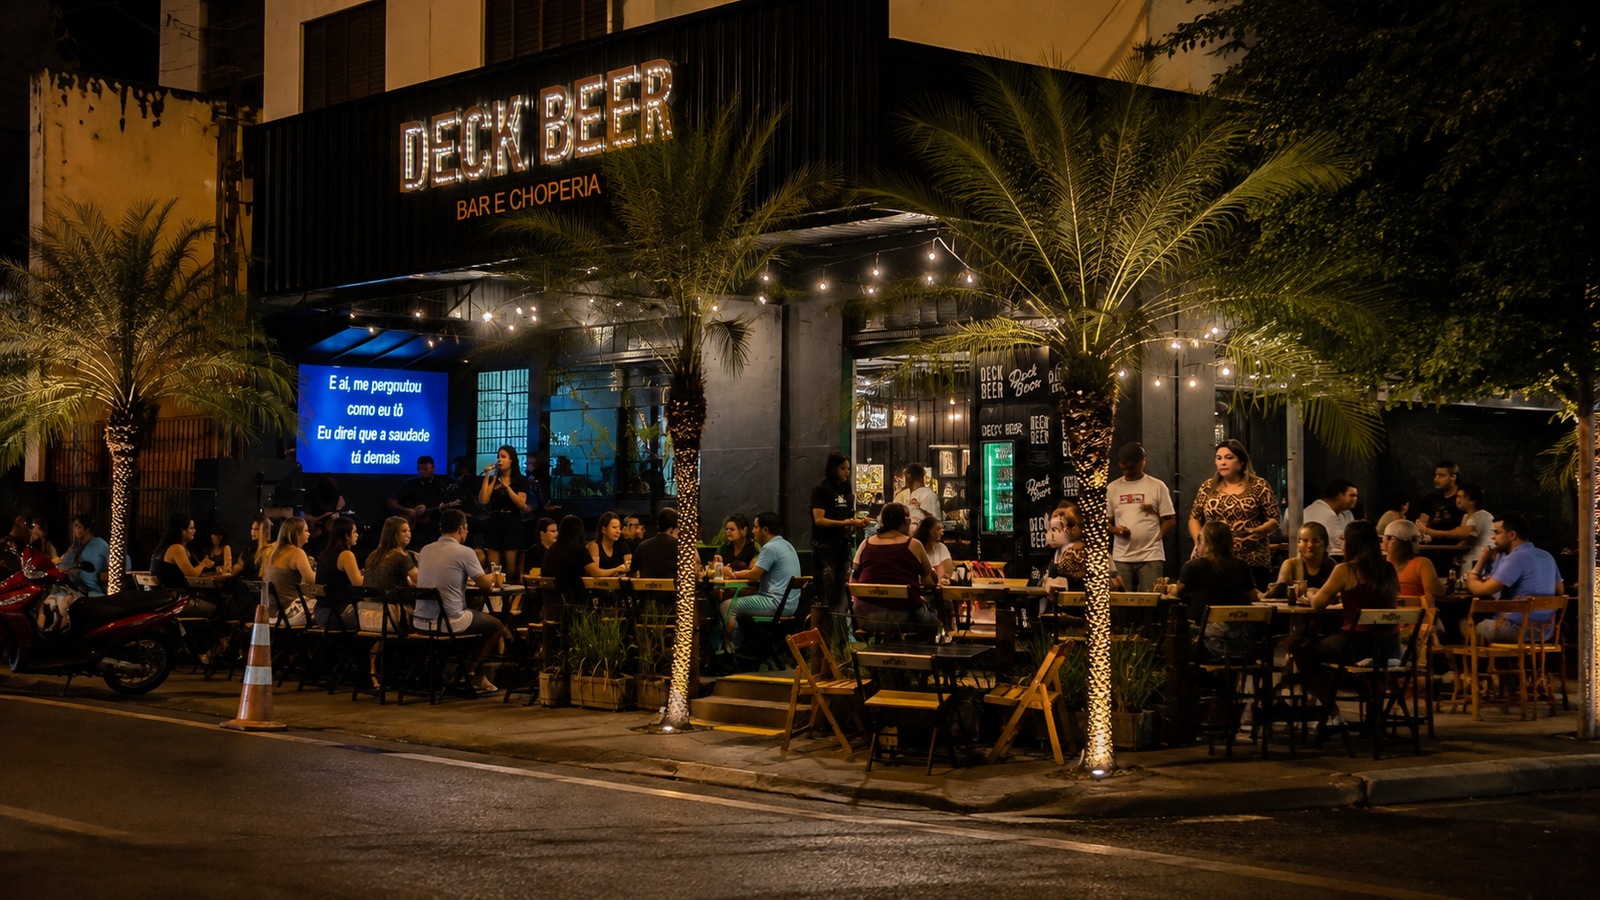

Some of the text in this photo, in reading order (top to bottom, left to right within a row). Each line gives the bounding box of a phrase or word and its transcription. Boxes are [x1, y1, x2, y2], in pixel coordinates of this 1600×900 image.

[399, 58, 674, 193] DECK BEER
[456, 173, 602, 221] BAR E CHOPERIA
[980, 364, 1004, 382] DECK
[329, 374, 337, 390] E
[353, 379, 370, 391] me
[981, 381, 1004, 400] BEER
[347, 404, 375, 416] como
[377, 405, 391, 417] eu
[317, 425, 430, 444] Eu direi que a saudade
[350, 449, 401, 465] tá demais
